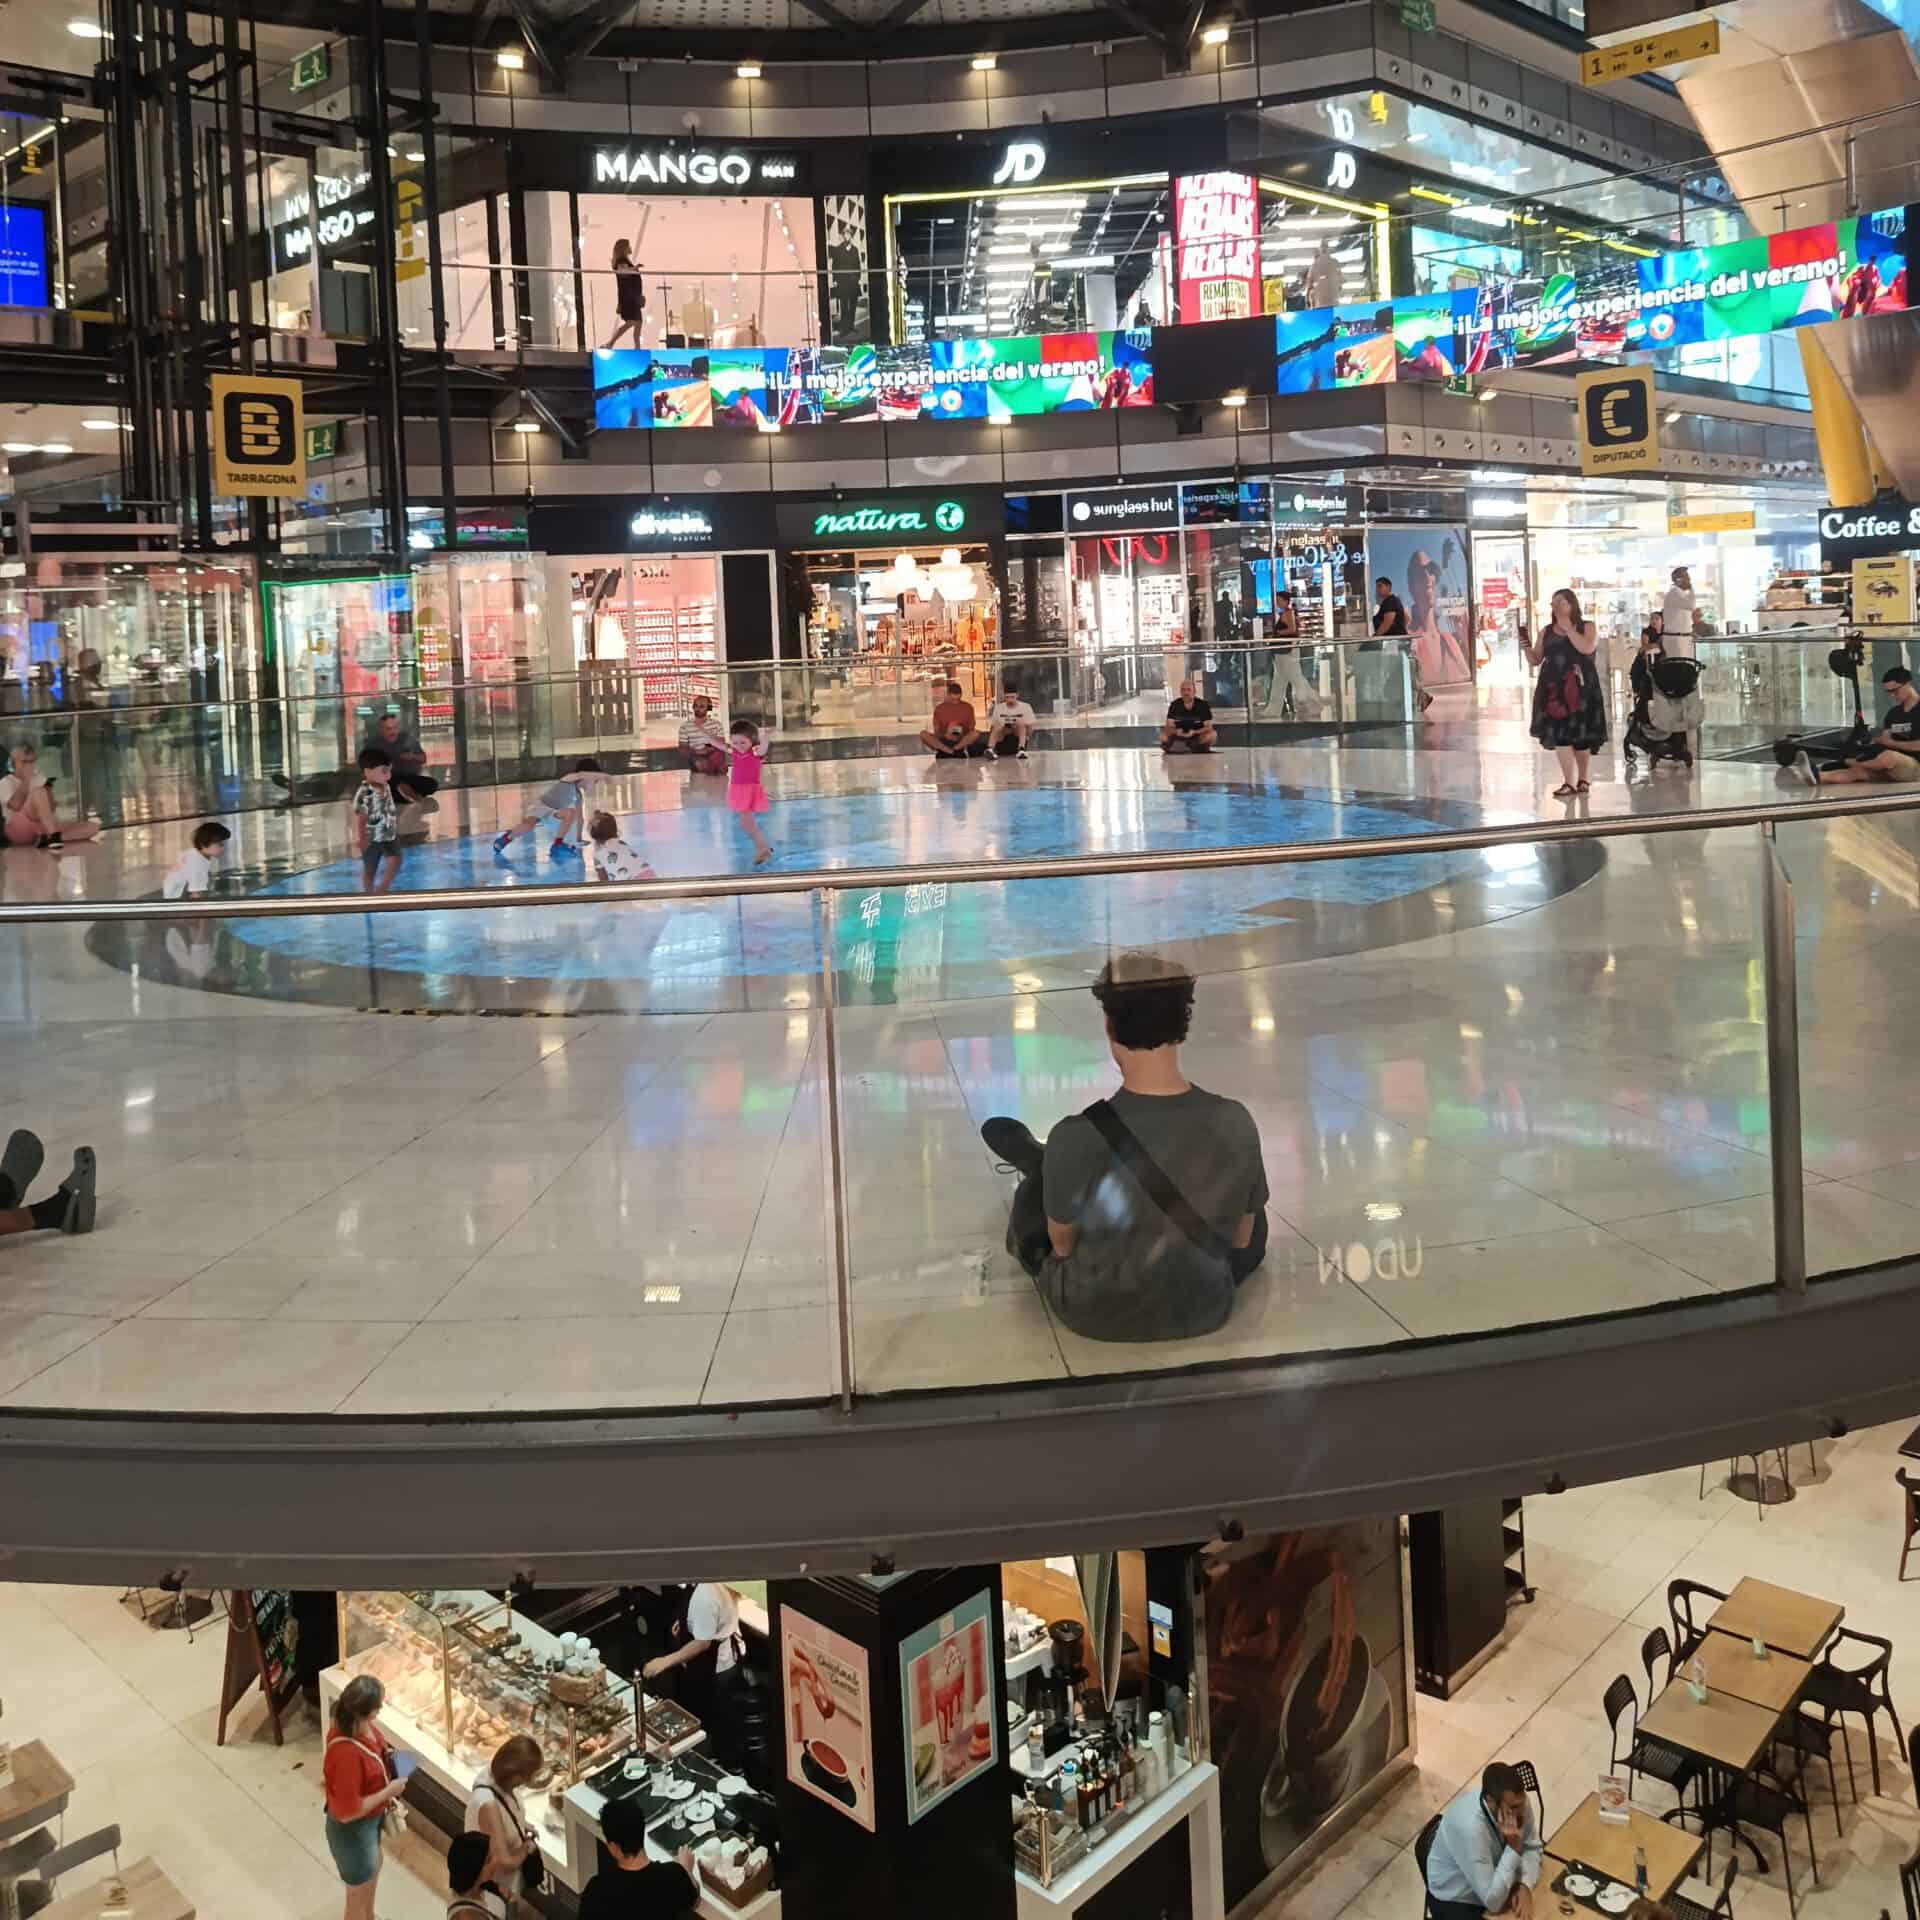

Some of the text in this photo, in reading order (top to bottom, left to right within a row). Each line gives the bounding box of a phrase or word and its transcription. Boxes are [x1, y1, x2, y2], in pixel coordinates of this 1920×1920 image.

[1592, 58, 1603, 76] 1
[596, 152, 751, 184] MANGO
[993, 143, 1046, 184] JD
[1327, 151, 1356, 189] JD
[1457, 250, 1848, 336] ¡La mejor experiencia del verano!
[806, 370, 864, 391] mejor
[868, 366, 988, 388] experiencia
[992, 364, 1024, 380] del
[1027, 359, 1104, 378] verano!
[241, 402, 280, 455] B
[1601, 389, 1632, 437] C
[1592, 448, 1647, 464] DIPUTACIÓ
[227, 473, 297, 485] TARRAGONA
[814, 508, 927, 535] natura
[1093, 497, 1174, 518] sunglass hut
[1821, 513, 1901, 539] Coffee
